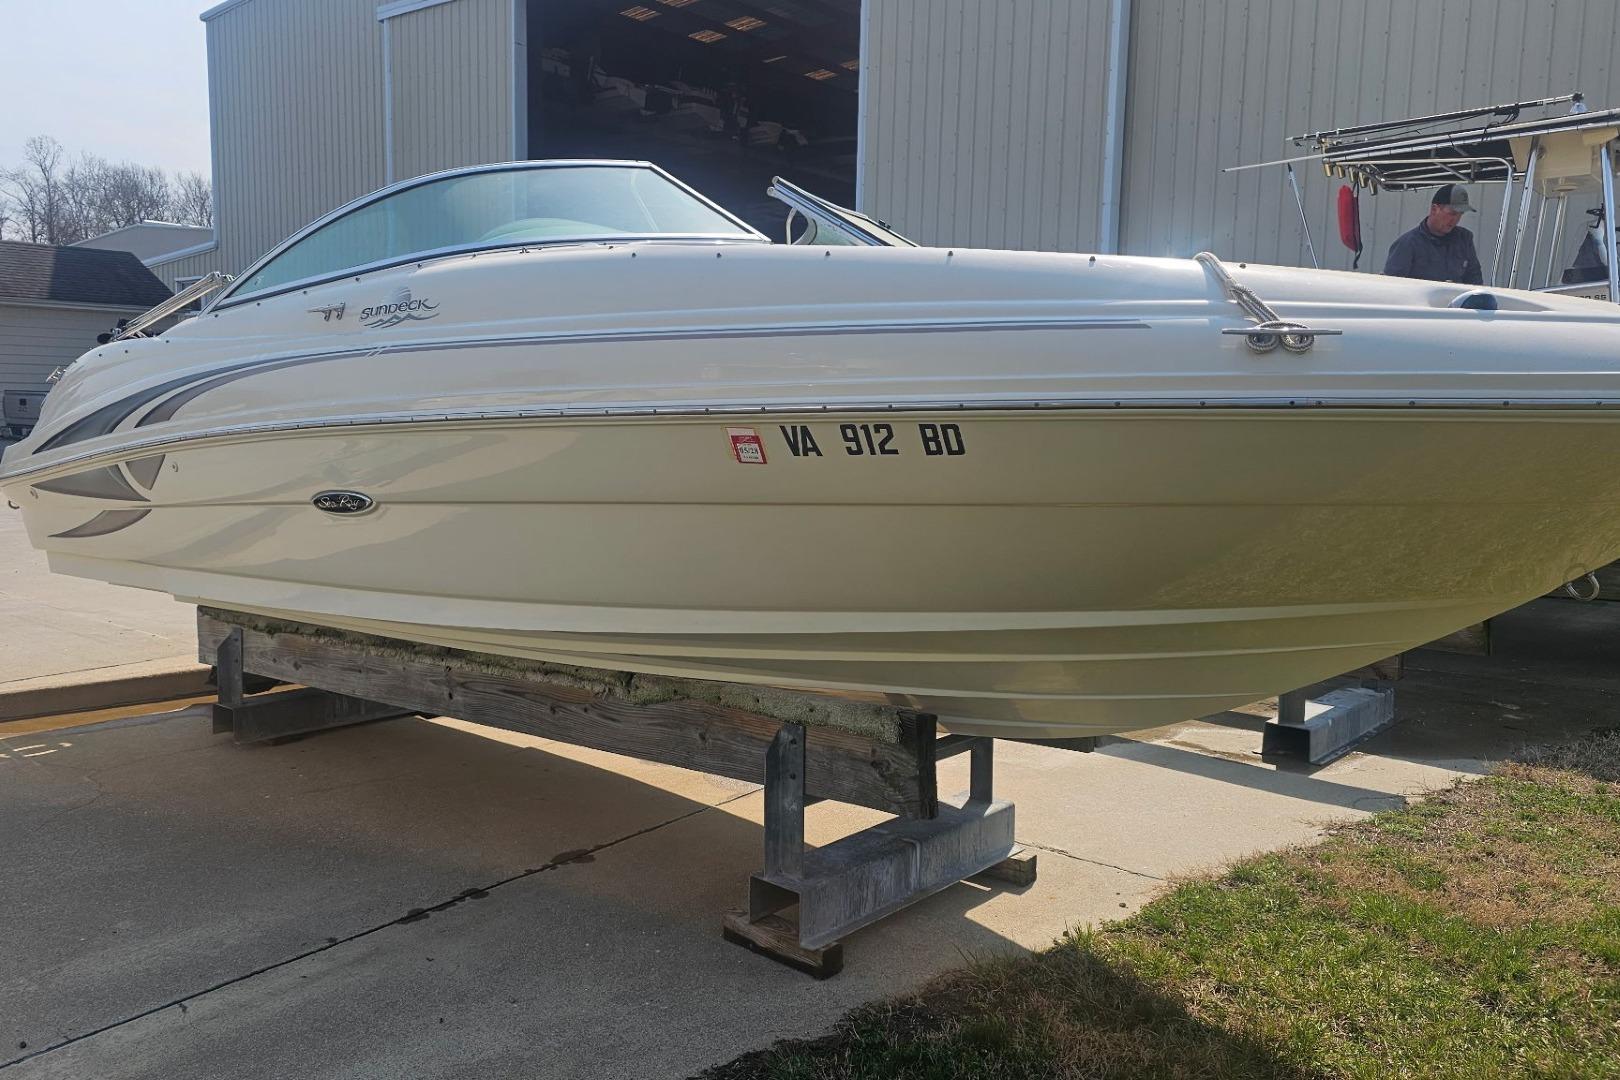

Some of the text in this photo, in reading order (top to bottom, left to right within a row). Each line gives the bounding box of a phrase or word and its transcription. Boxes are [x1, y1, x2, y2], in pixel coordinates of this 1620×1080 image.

[779, 423, 966, 457] VA 912 BD
[318, 494, 360, 510] Sea Ray
